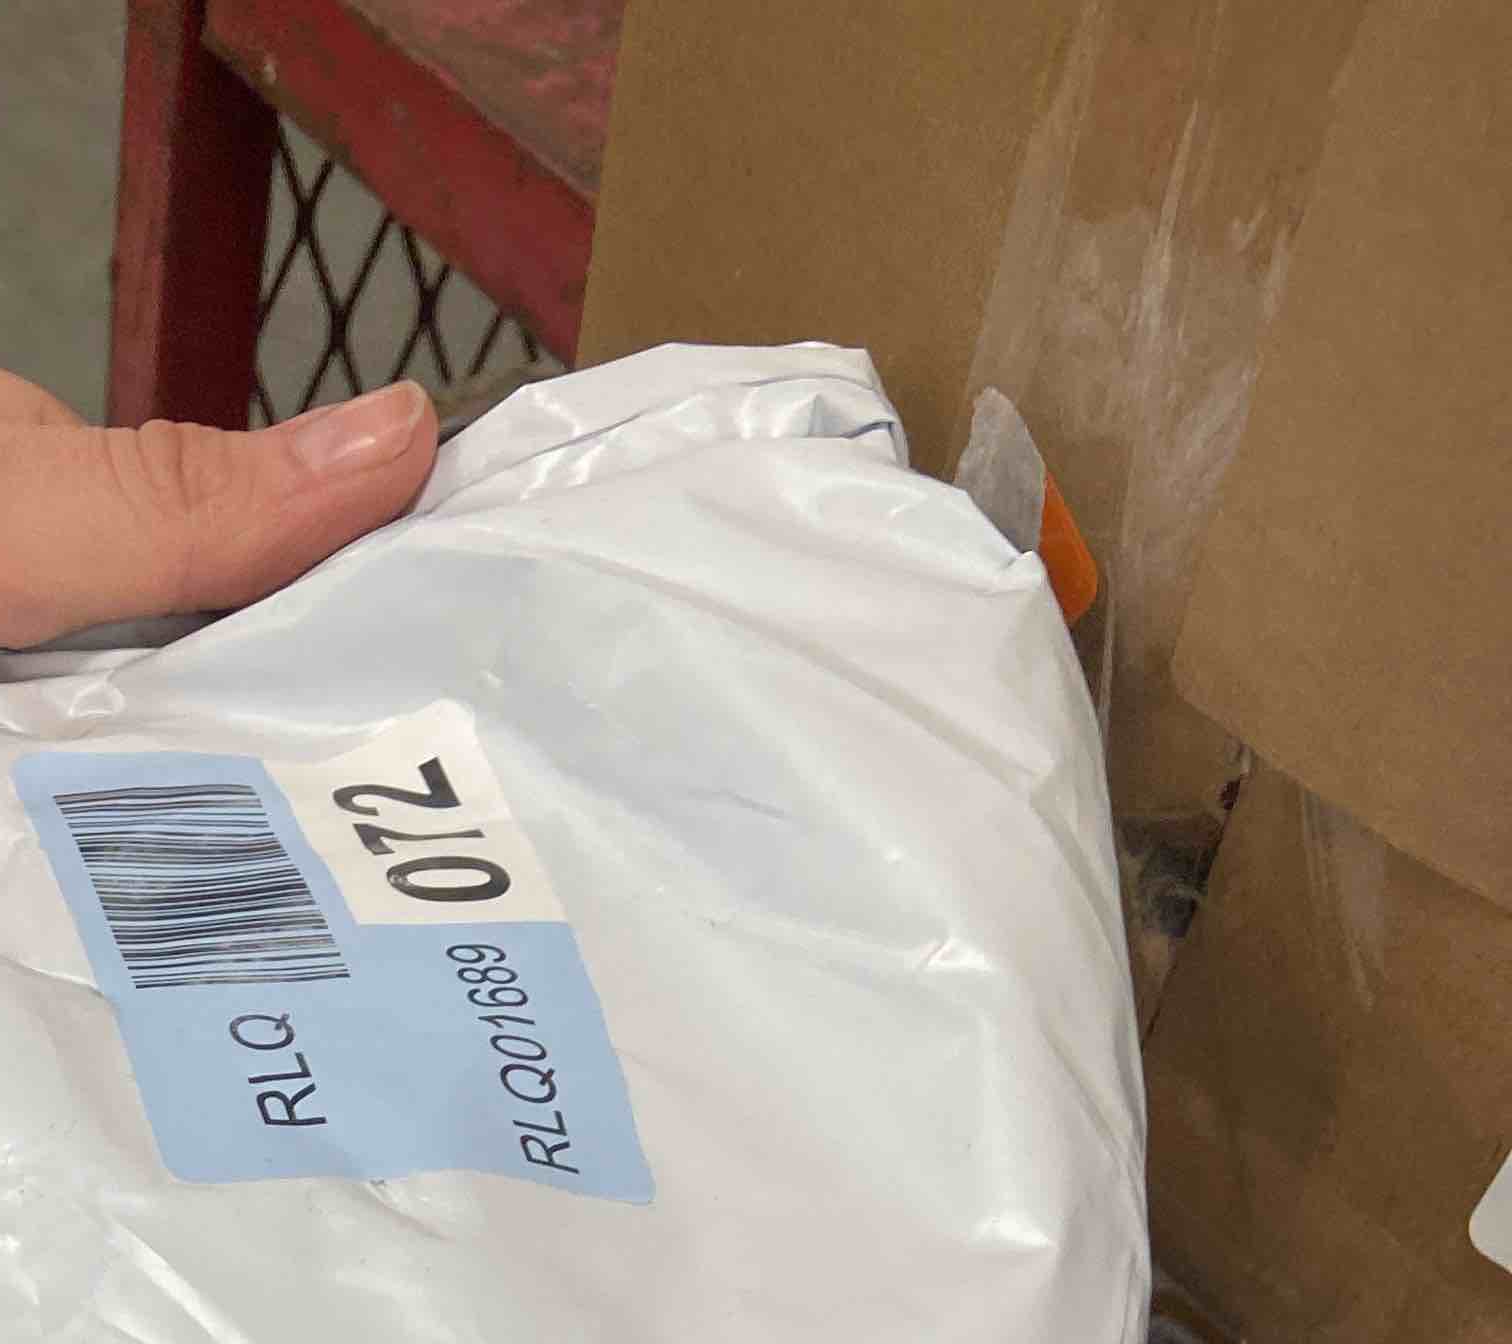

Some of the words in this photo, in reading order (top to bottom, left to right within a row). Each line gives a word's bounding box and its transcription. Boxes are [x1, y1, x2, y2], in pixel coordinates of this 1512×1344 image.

[332, 755, 511, 902] 072
[228, 1012, 329, 1126] RLQ
[445, 943, 580, 1175] RLQ01689
